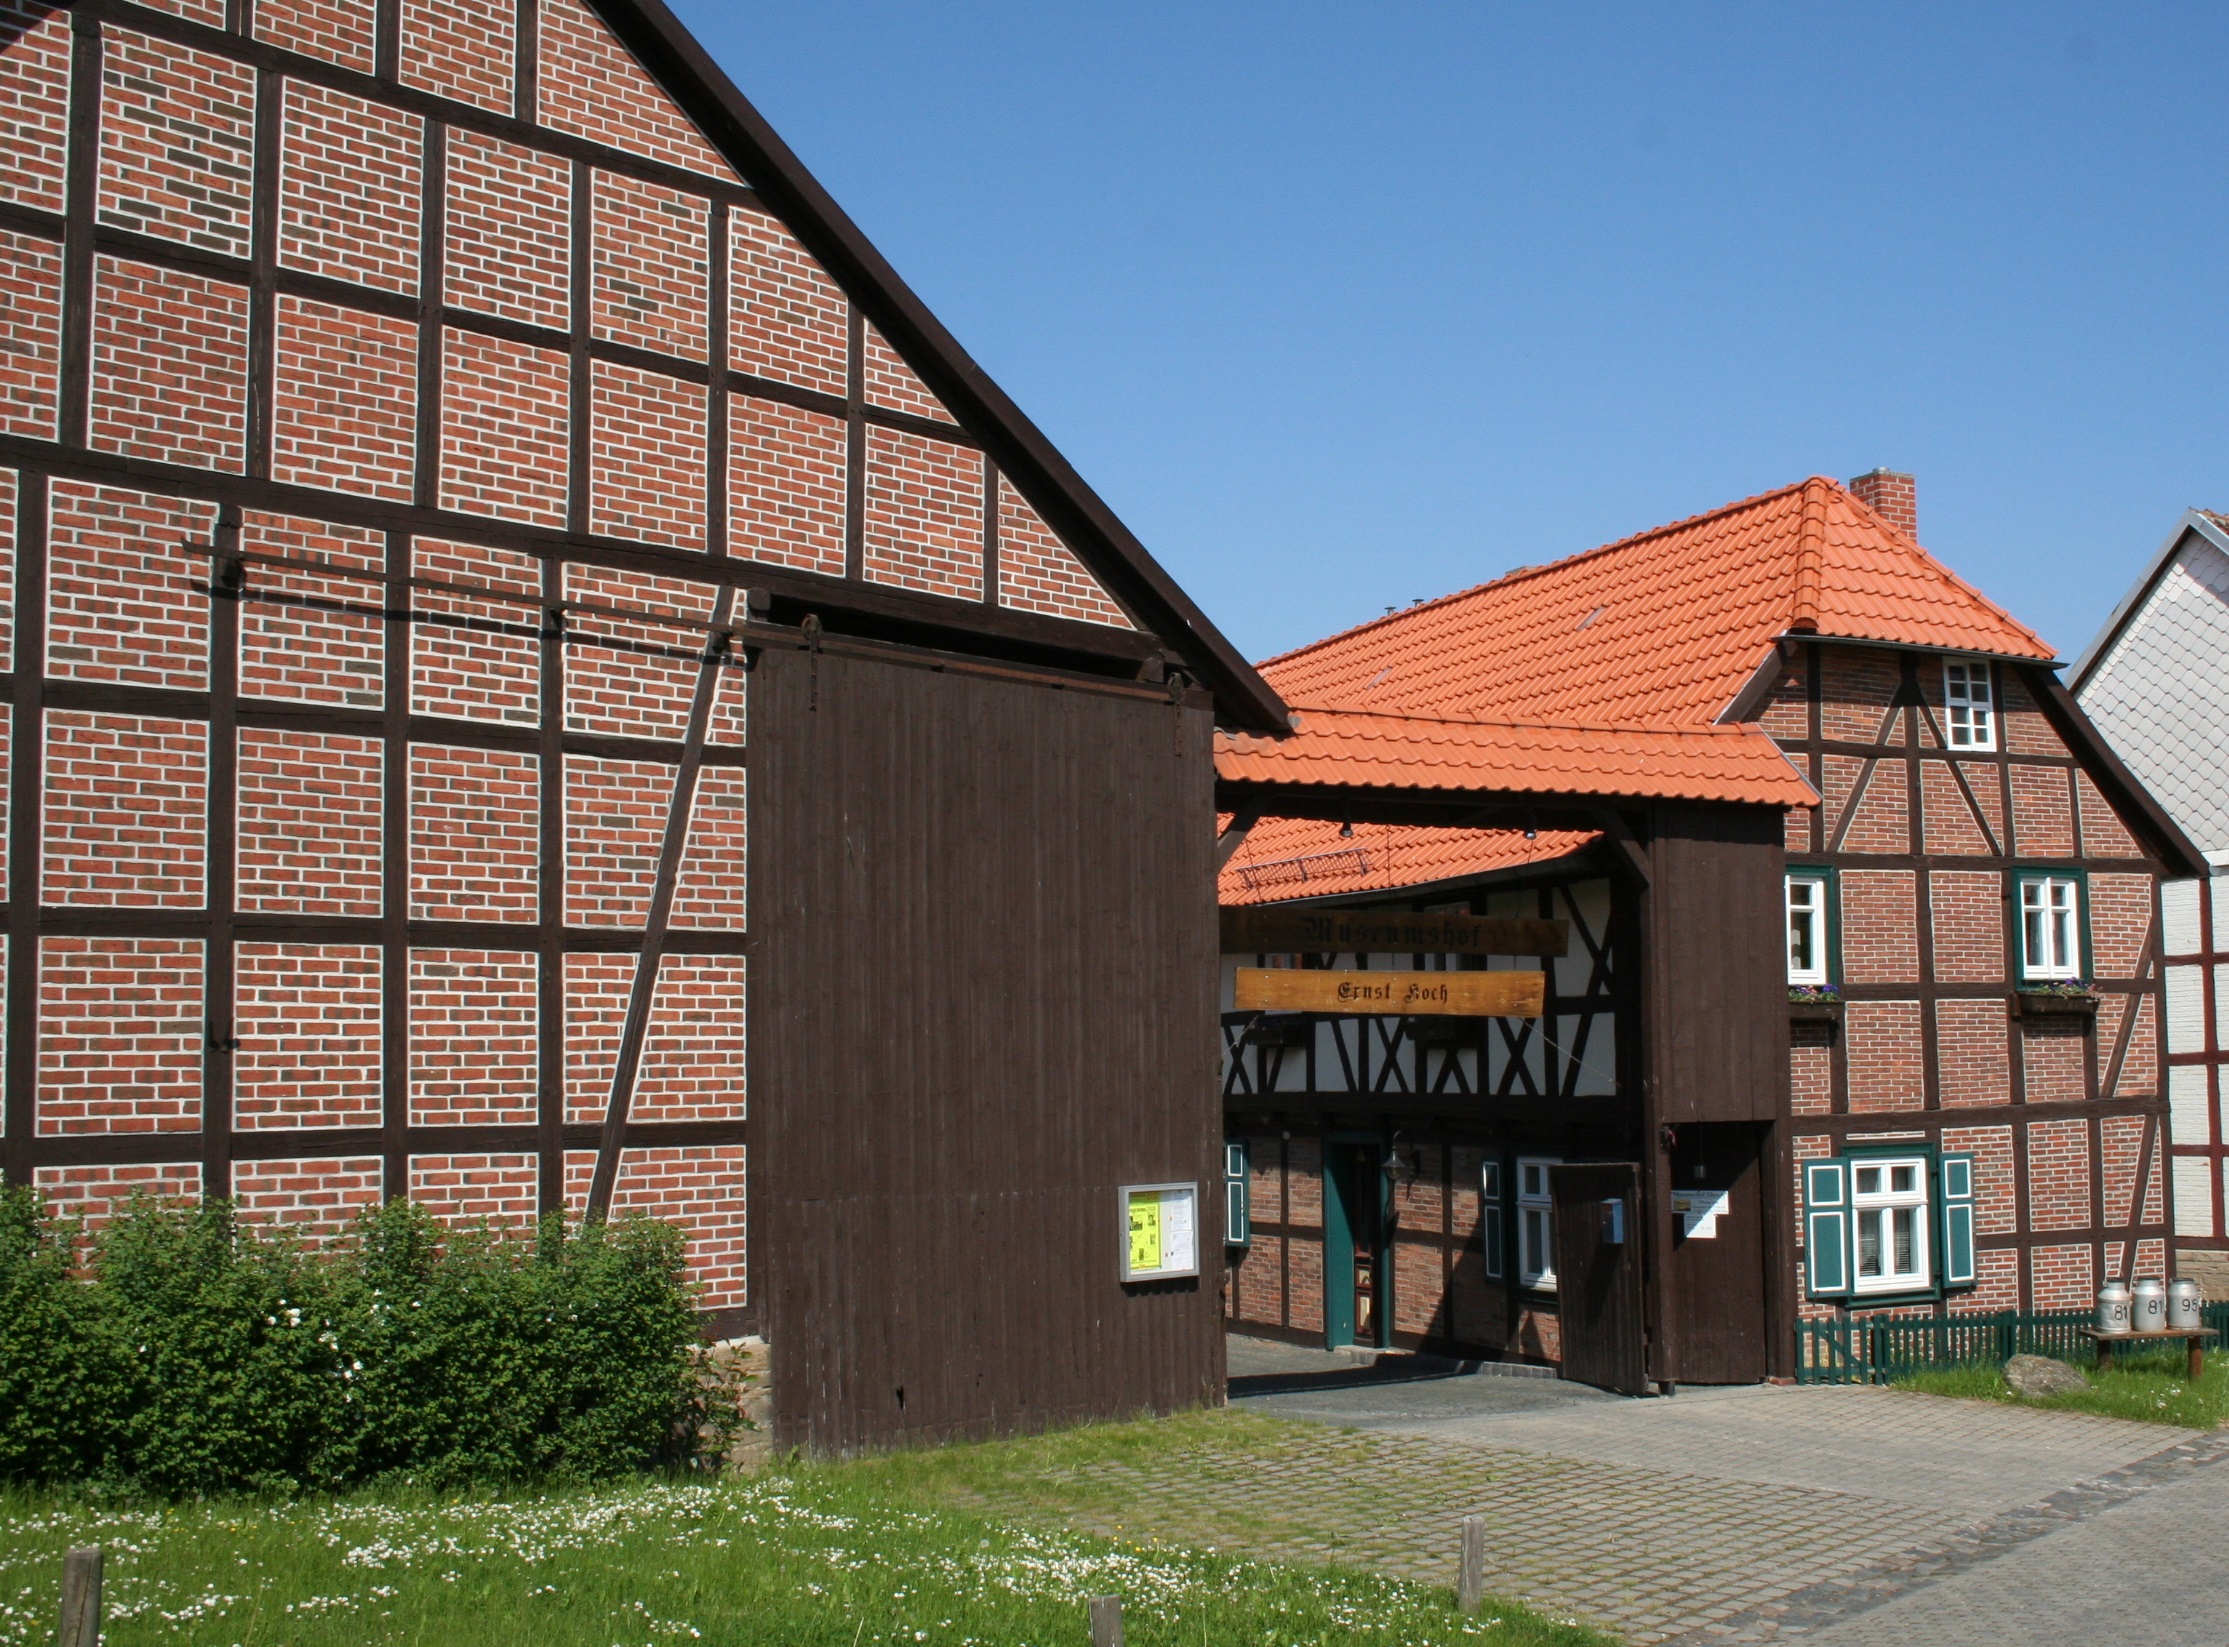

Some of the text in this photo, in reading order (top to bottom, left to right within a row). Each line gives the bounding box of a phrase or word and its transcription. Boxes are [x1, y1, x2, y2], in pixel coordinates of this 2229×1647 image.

[1337, 981, 1448, 1003] Ernst Koch
[2115, 1305, 2128, 1320] 81
[2148, 1300, 2163, 1315] 81
[2182, 1298, 2198, 1312] 95
